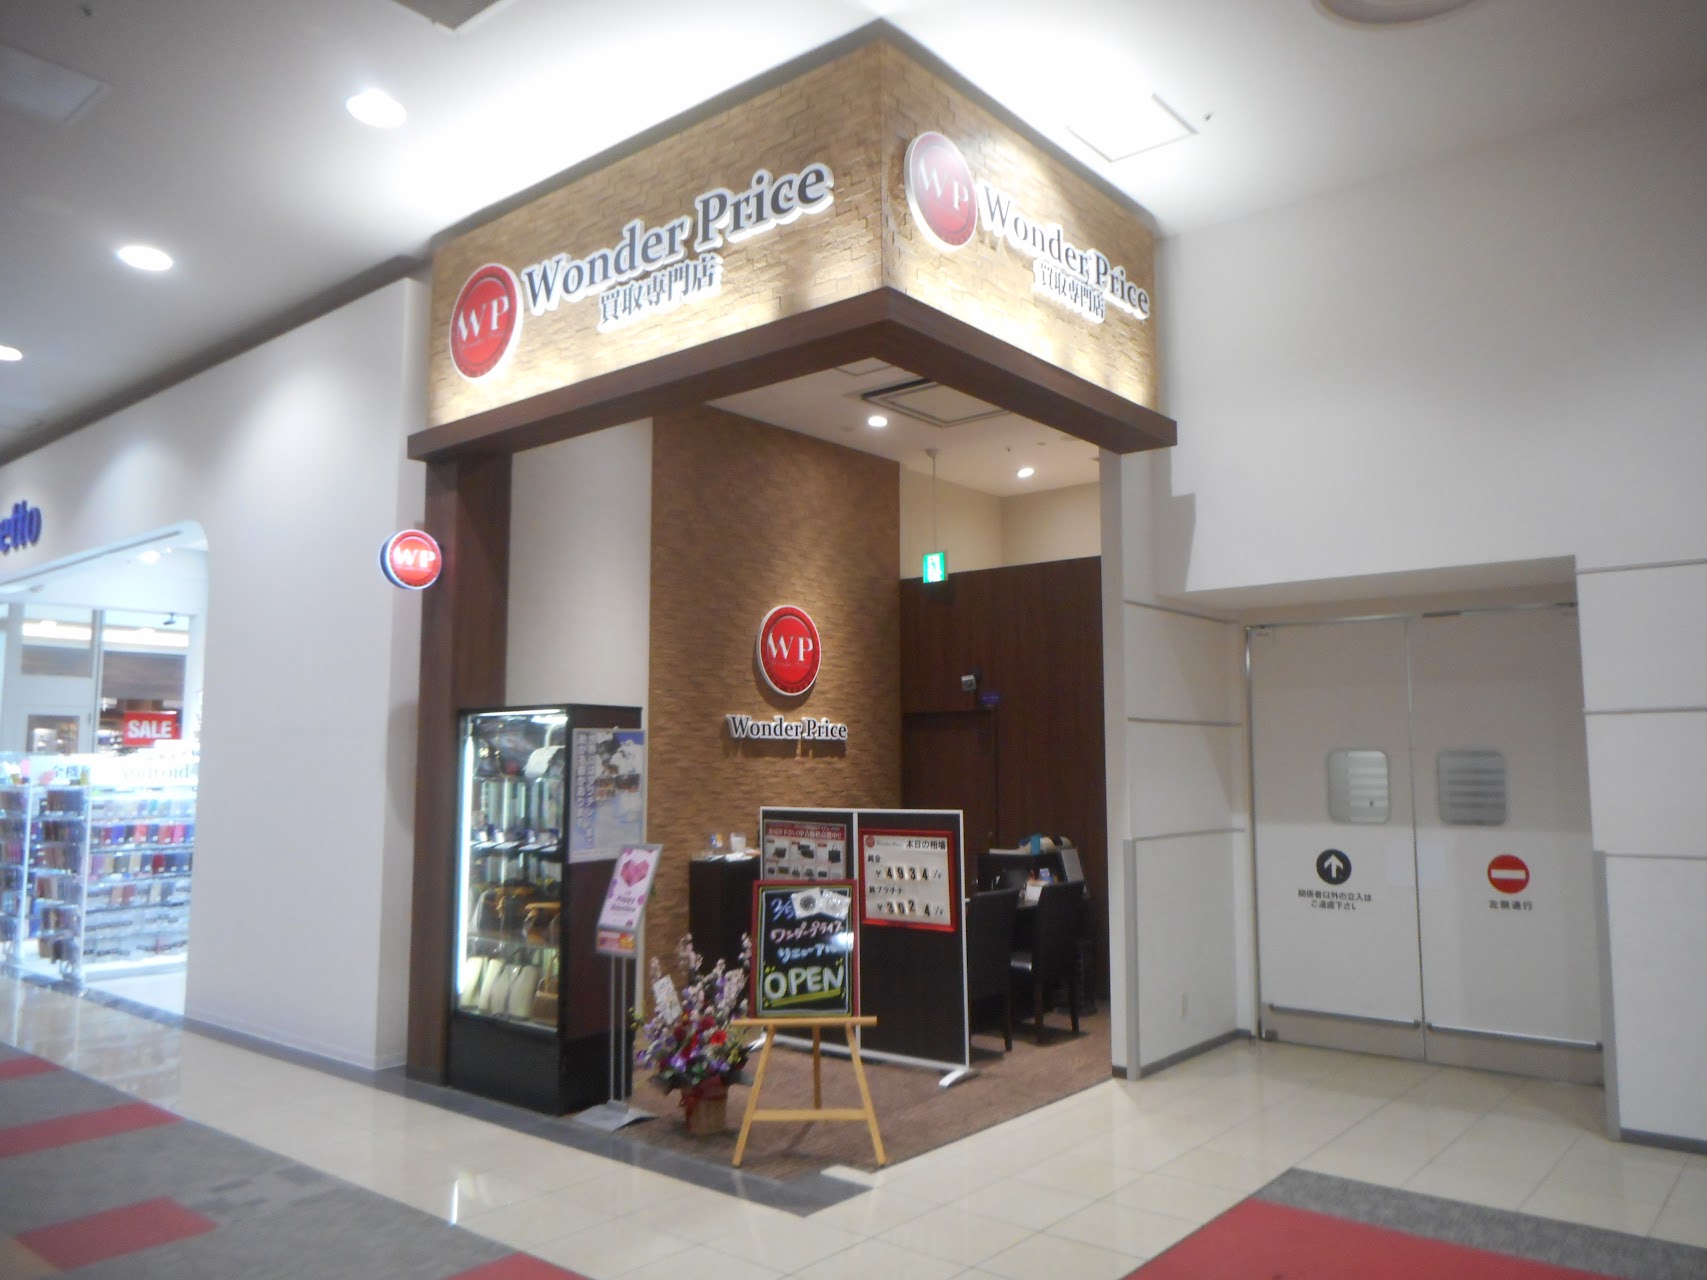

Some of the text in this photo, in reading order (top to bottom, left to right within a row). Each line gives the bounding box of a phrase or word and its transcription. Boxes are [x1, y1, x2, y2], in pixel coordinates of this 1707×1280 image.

[919, 156, 970, 212] WP
[523, 166, 826, 310] Wonder Price
[983, 185, 1150, 315] Wonder Price
[600, 256, 717, 323] 買取専門店
[1040, 262, 1105, 320] 買取専門店
[457, 295, 509, 341] WP
[393, 546, 436, 568] WP
[767, 632, 814, 662] WP
[128, 719, 172, 738] SALE
[730, 716, 847, 739] Wonder Price
[905, 839, 946, 850] 本日の相場
[764, 965, 845, 1000] OPEN
